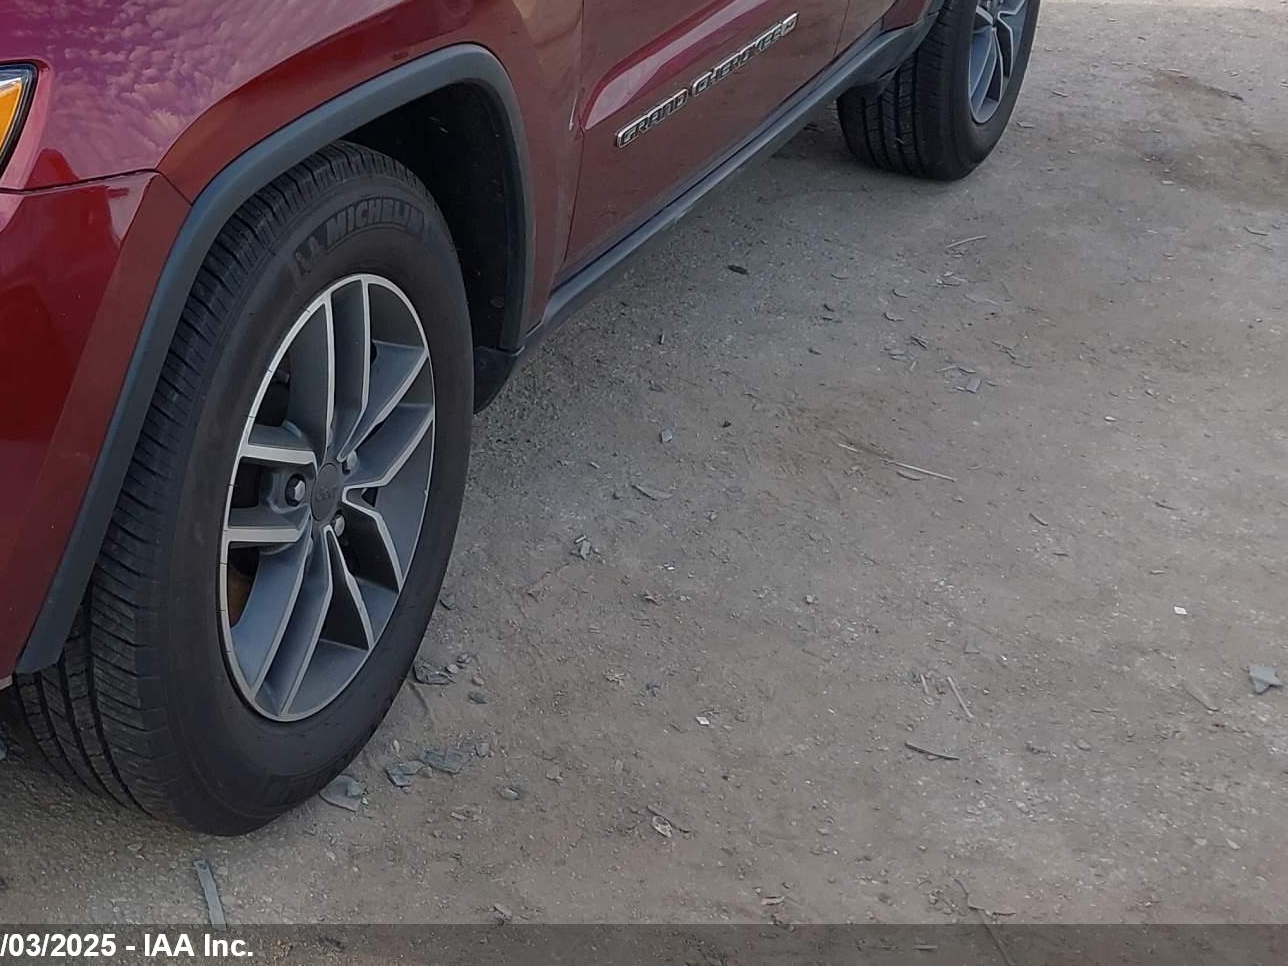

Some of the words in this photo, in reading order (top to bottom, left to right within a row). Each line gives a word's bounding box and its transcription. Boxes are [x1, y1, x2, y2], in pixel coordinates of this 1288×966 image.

[616, 89, 689, 148] GRAND
[691, 11, 799, 98] CHEROKEE
[324, 197, 425, 249] MICHELIN
